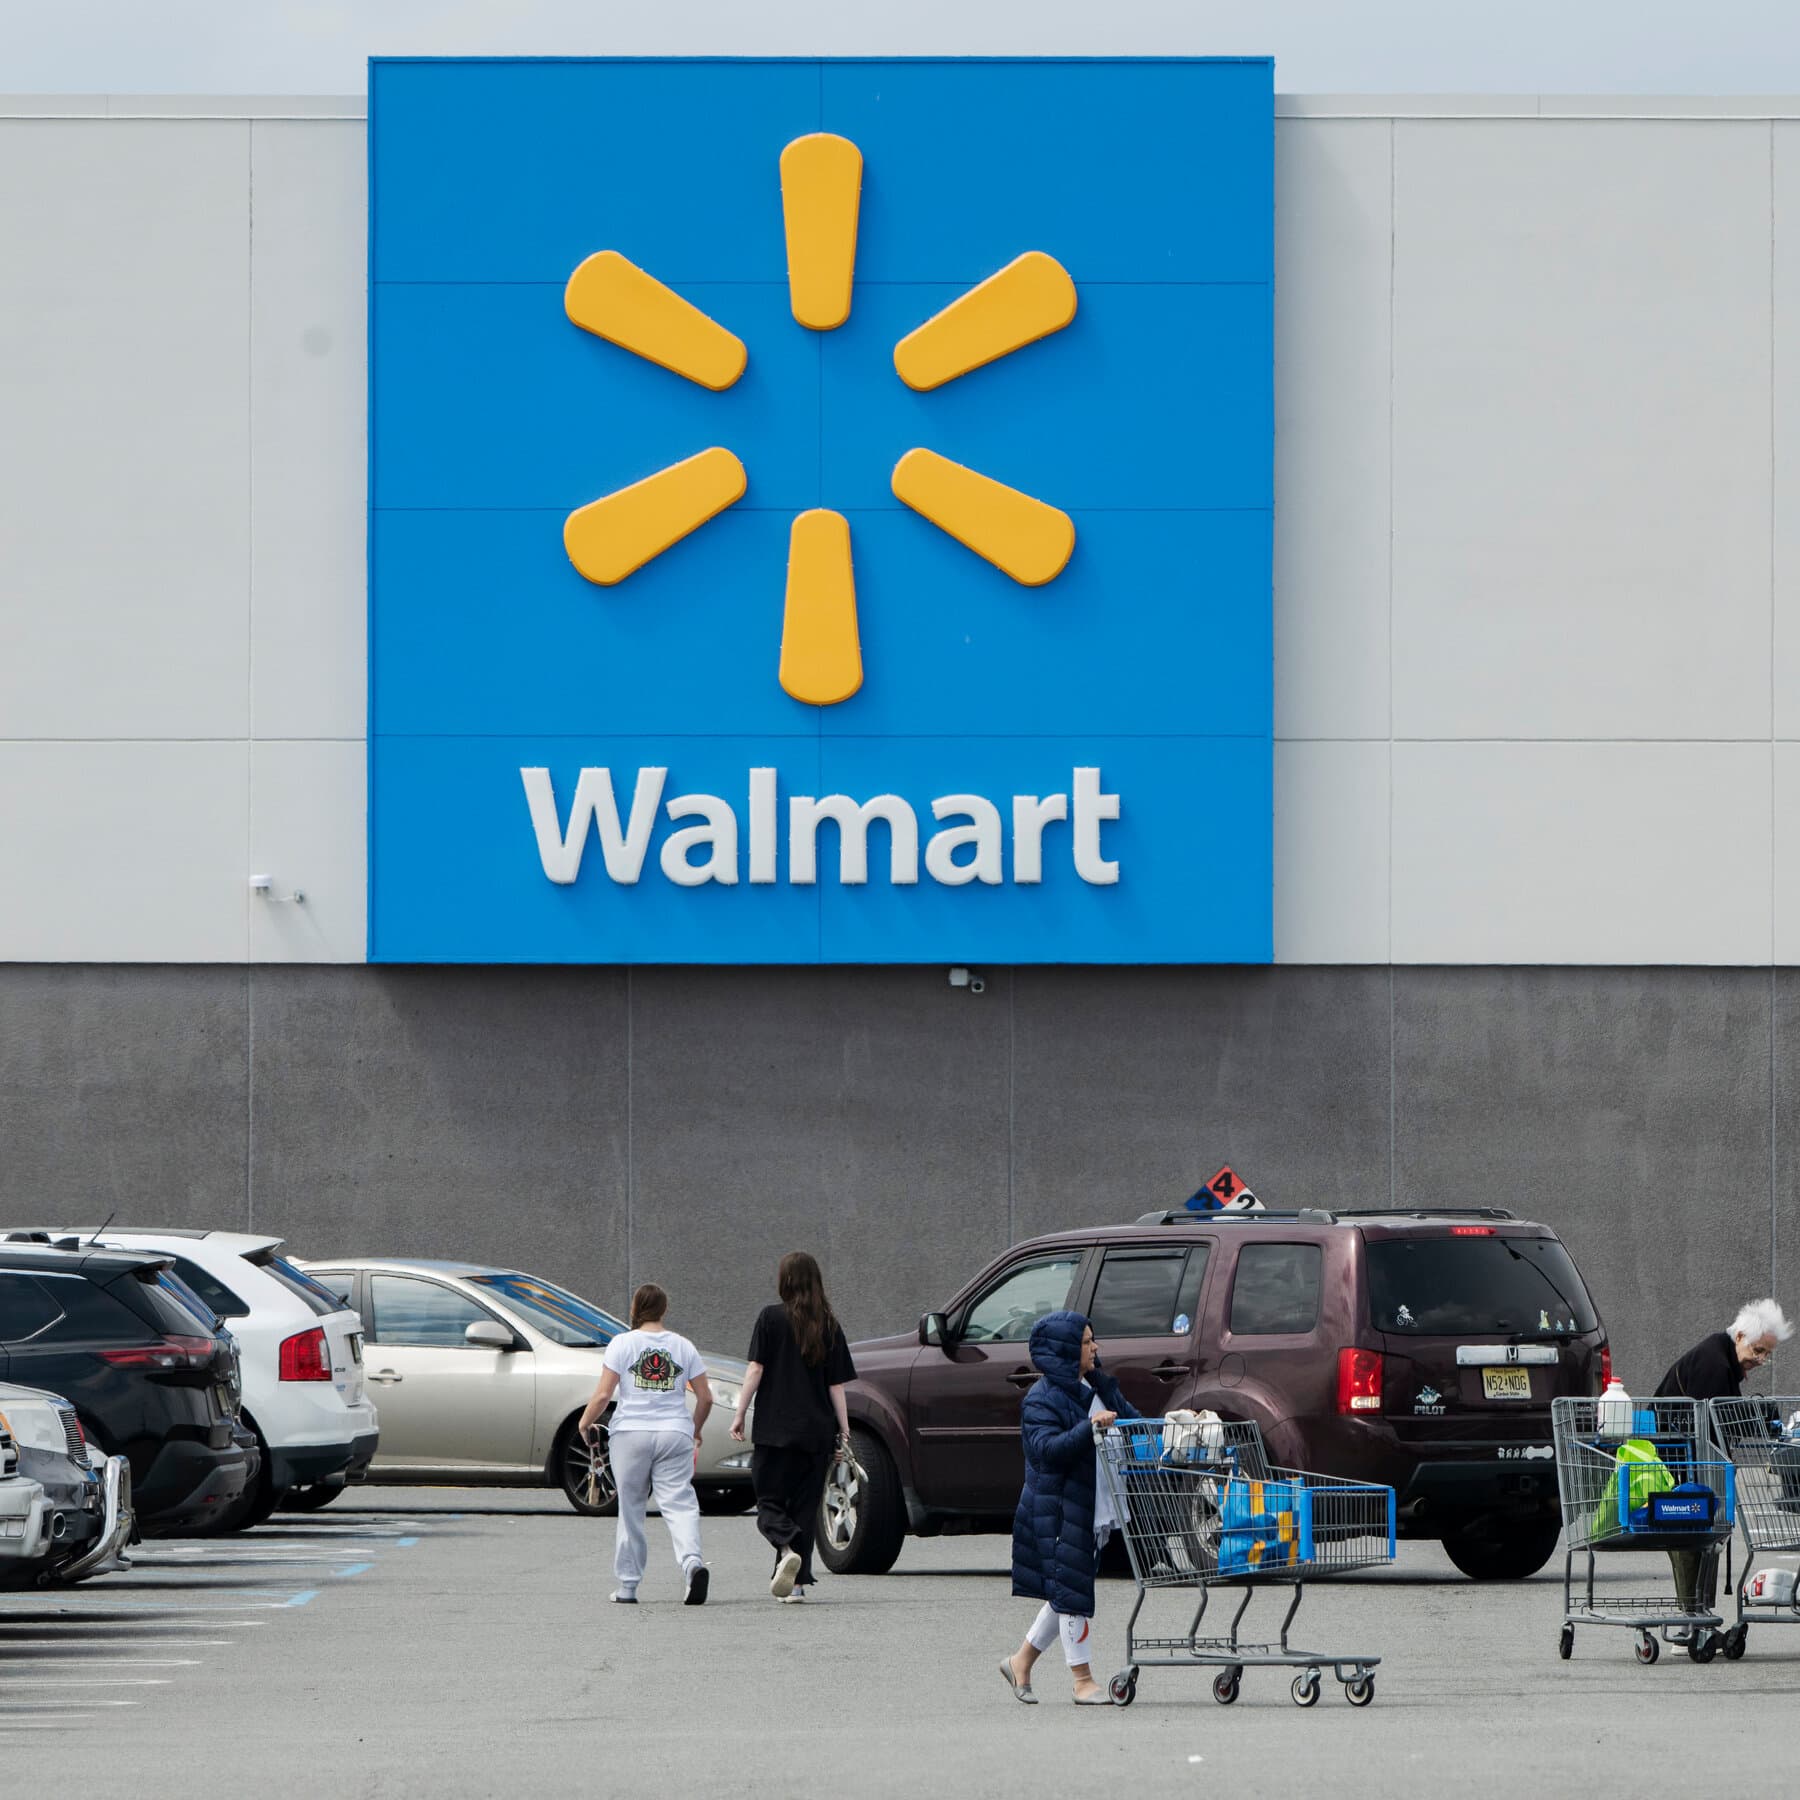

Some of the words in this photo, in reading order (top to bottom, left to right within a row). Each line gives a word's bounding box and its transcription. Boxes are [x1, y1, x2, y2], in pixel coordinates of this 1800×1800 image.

[519, 767, 1120, 886] Walmart
[1212, 1172, 1235, 1198] 4
[1237, 1194, 1256, 1210] 2
[1414, 1405, 1446, 1415] PILOT
[1661, 1504, 1691, 1512] Walmart
